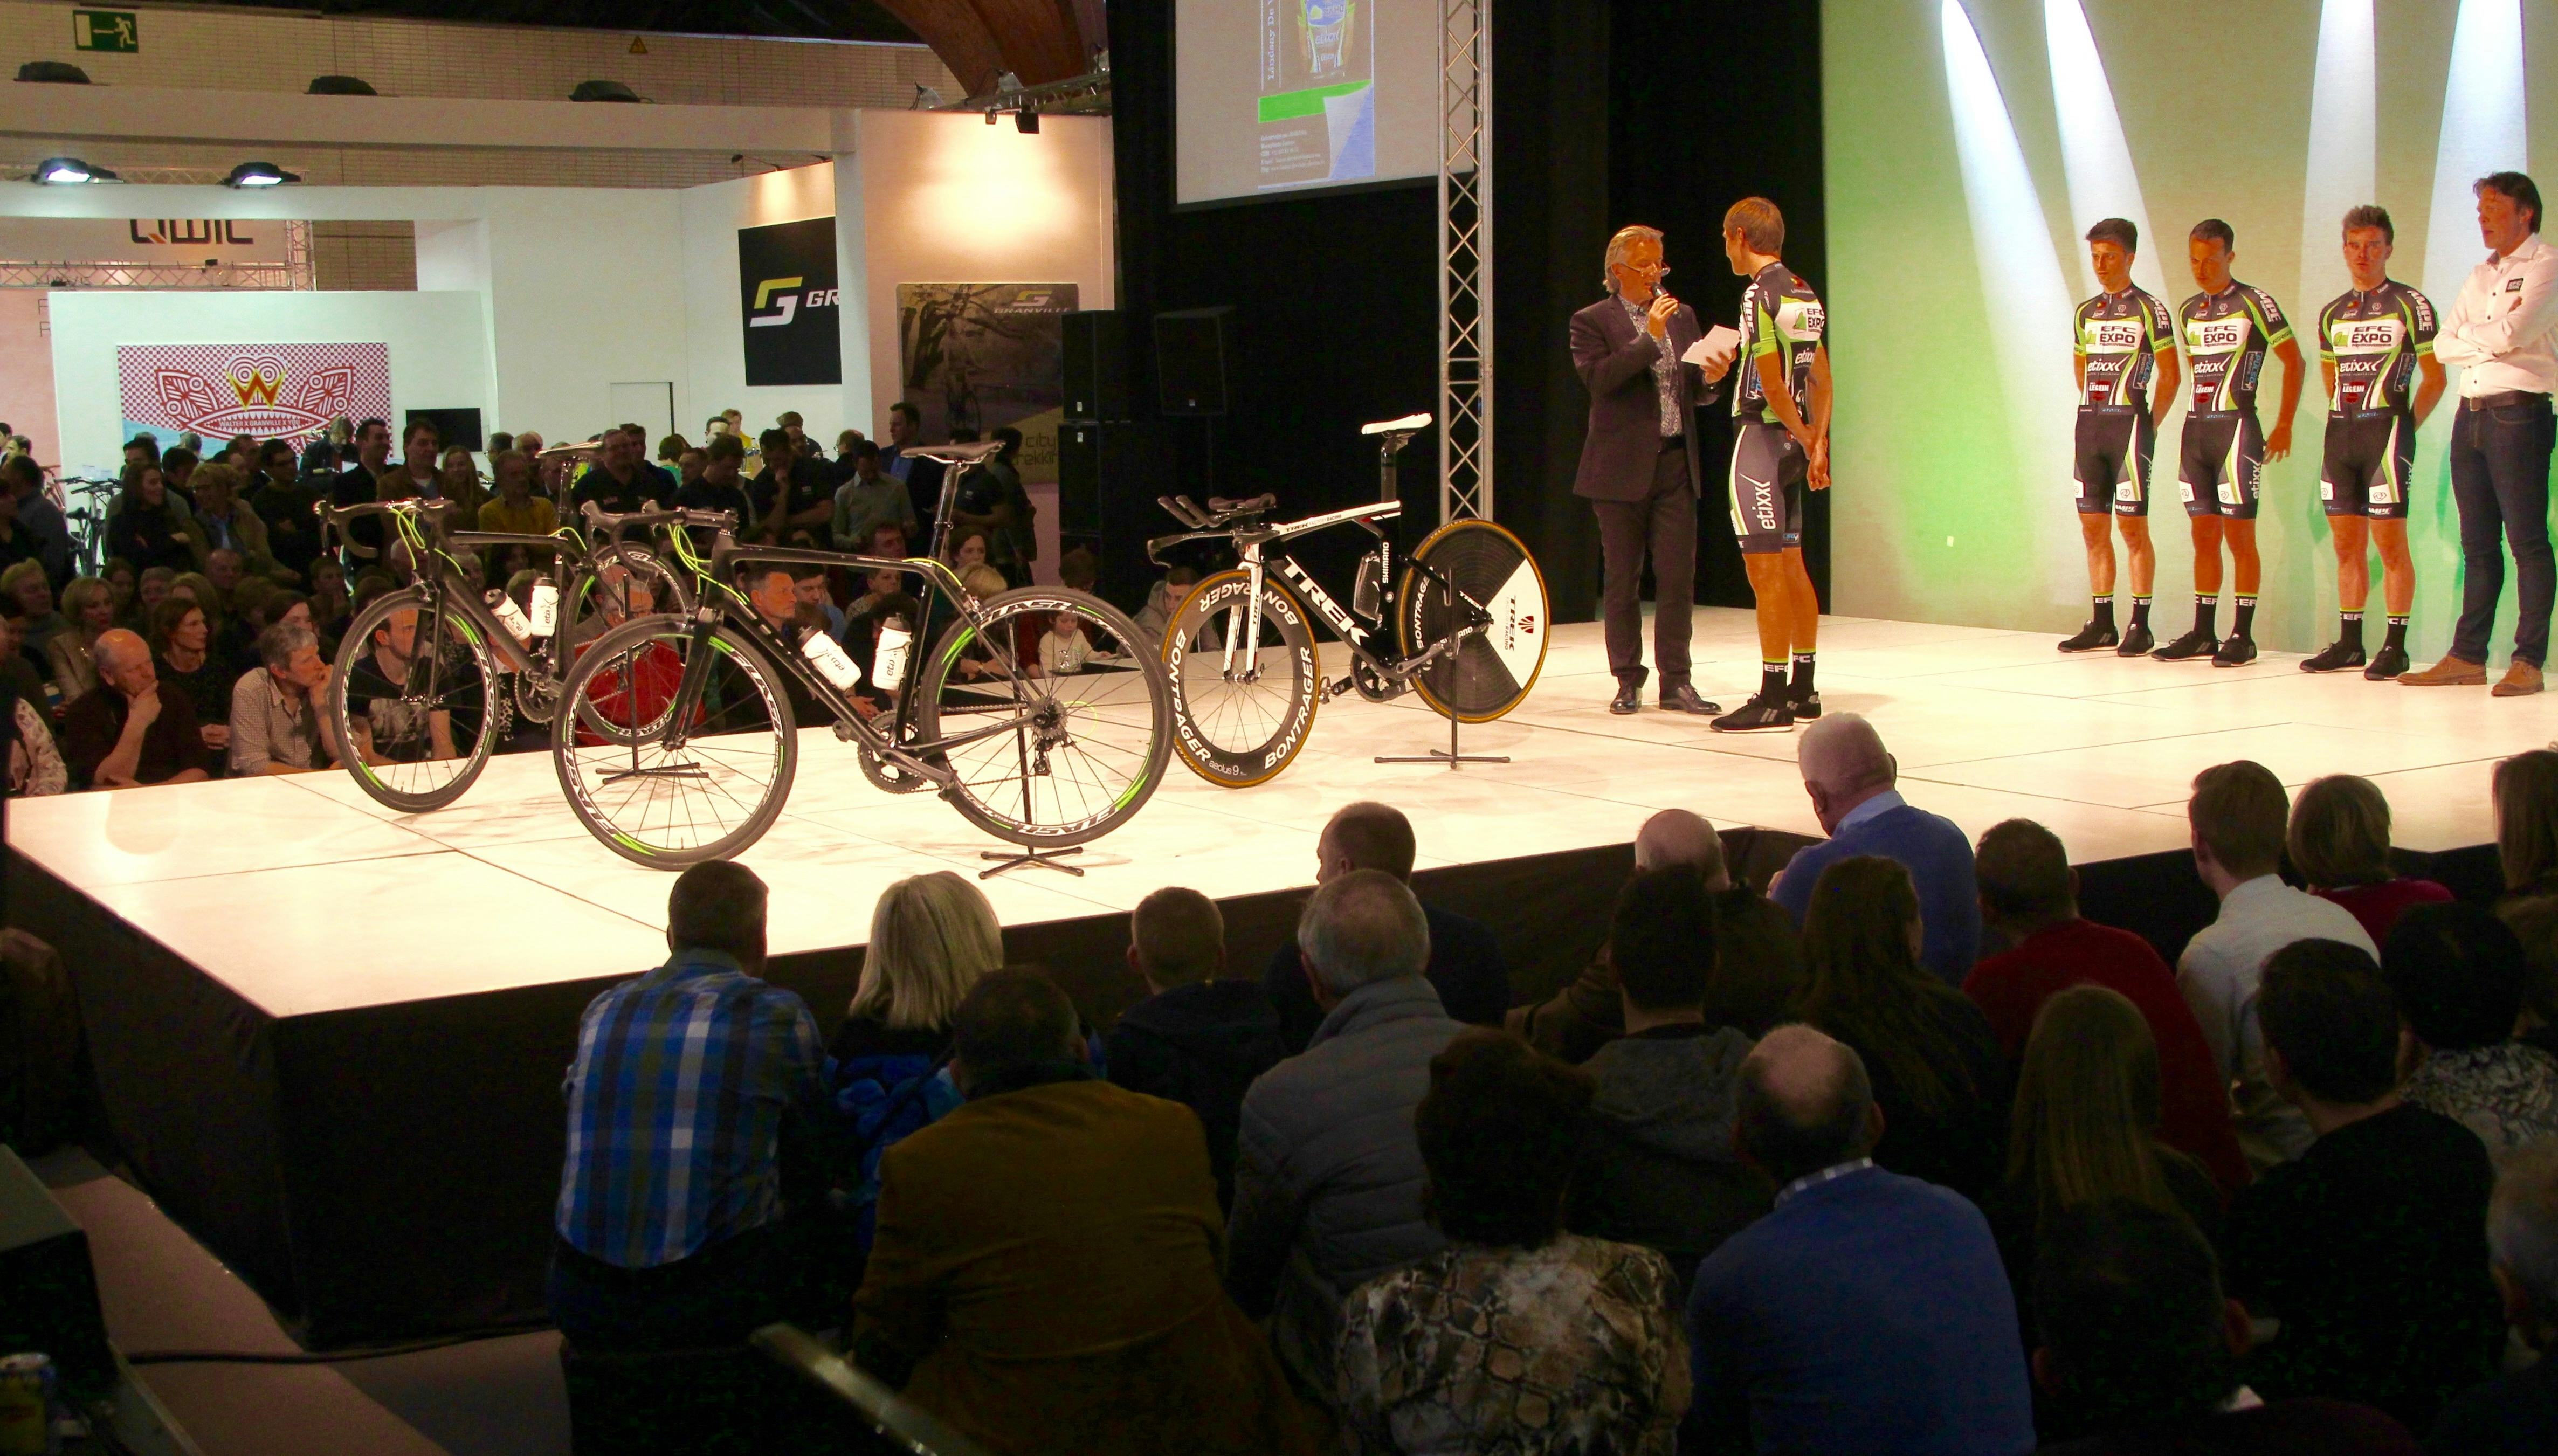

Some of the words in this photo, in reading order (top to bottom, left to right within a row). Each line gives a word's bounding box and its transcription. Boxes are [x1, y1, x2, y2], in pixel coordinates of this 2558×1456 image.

[2100, 333, 2135, 344] EXPO
[2101, 326, 2136, 335] EFC
[2204, 333, 2237, 343] EXPO
[2352, 334, 2392, 343] EXPO
[1285, 522, 1308, 533] TREK
[1284, 555, 1370, 646] TREK
[1460, 590, 1484, 611] TREK
[1415, 576, 1430, 650] BONTRAGE
[1508, 595, 1516, 652] TREK
[1169, 628, 1212, 762] BONTRAGER
[1265, 646, 1314, 769] BONTRAGER
